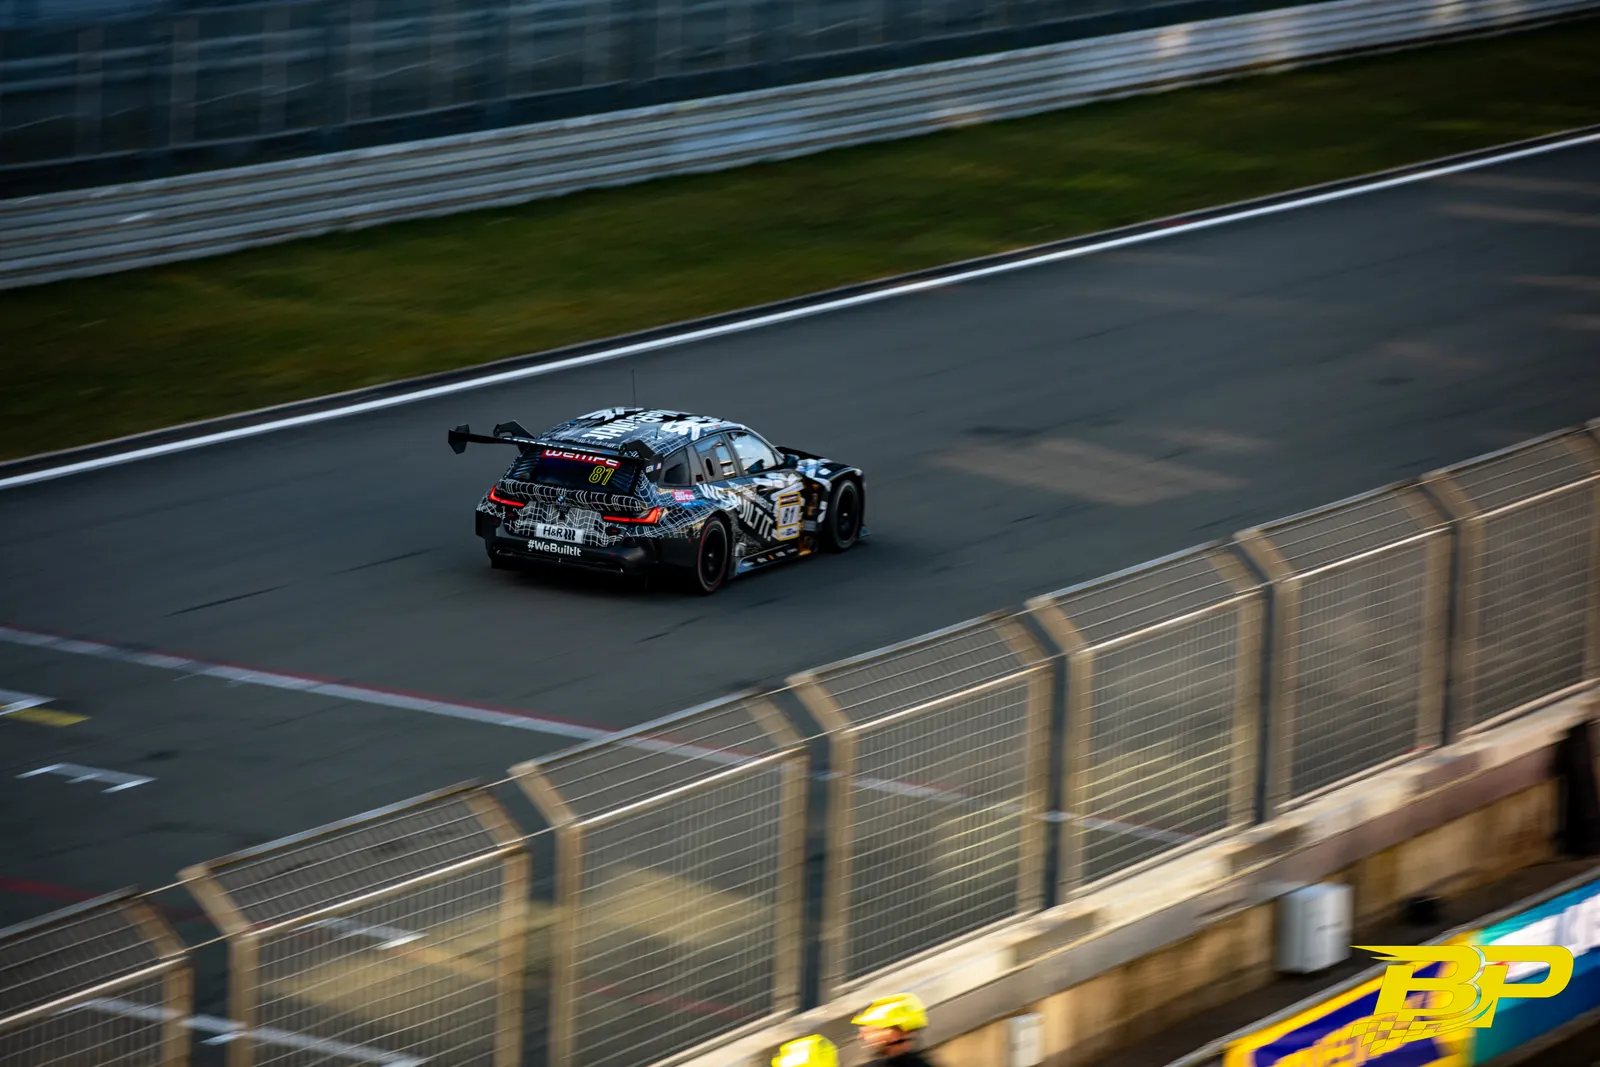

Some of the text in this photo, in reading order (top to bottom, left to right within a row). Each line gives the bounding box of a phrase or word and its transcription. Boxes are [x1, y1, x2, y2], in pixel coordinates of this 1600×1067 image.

[588, 465, 615, 486] 81
[543, 525, 563, 538] H&R
[527, 539, 581, 557] #WeBuiltIt
